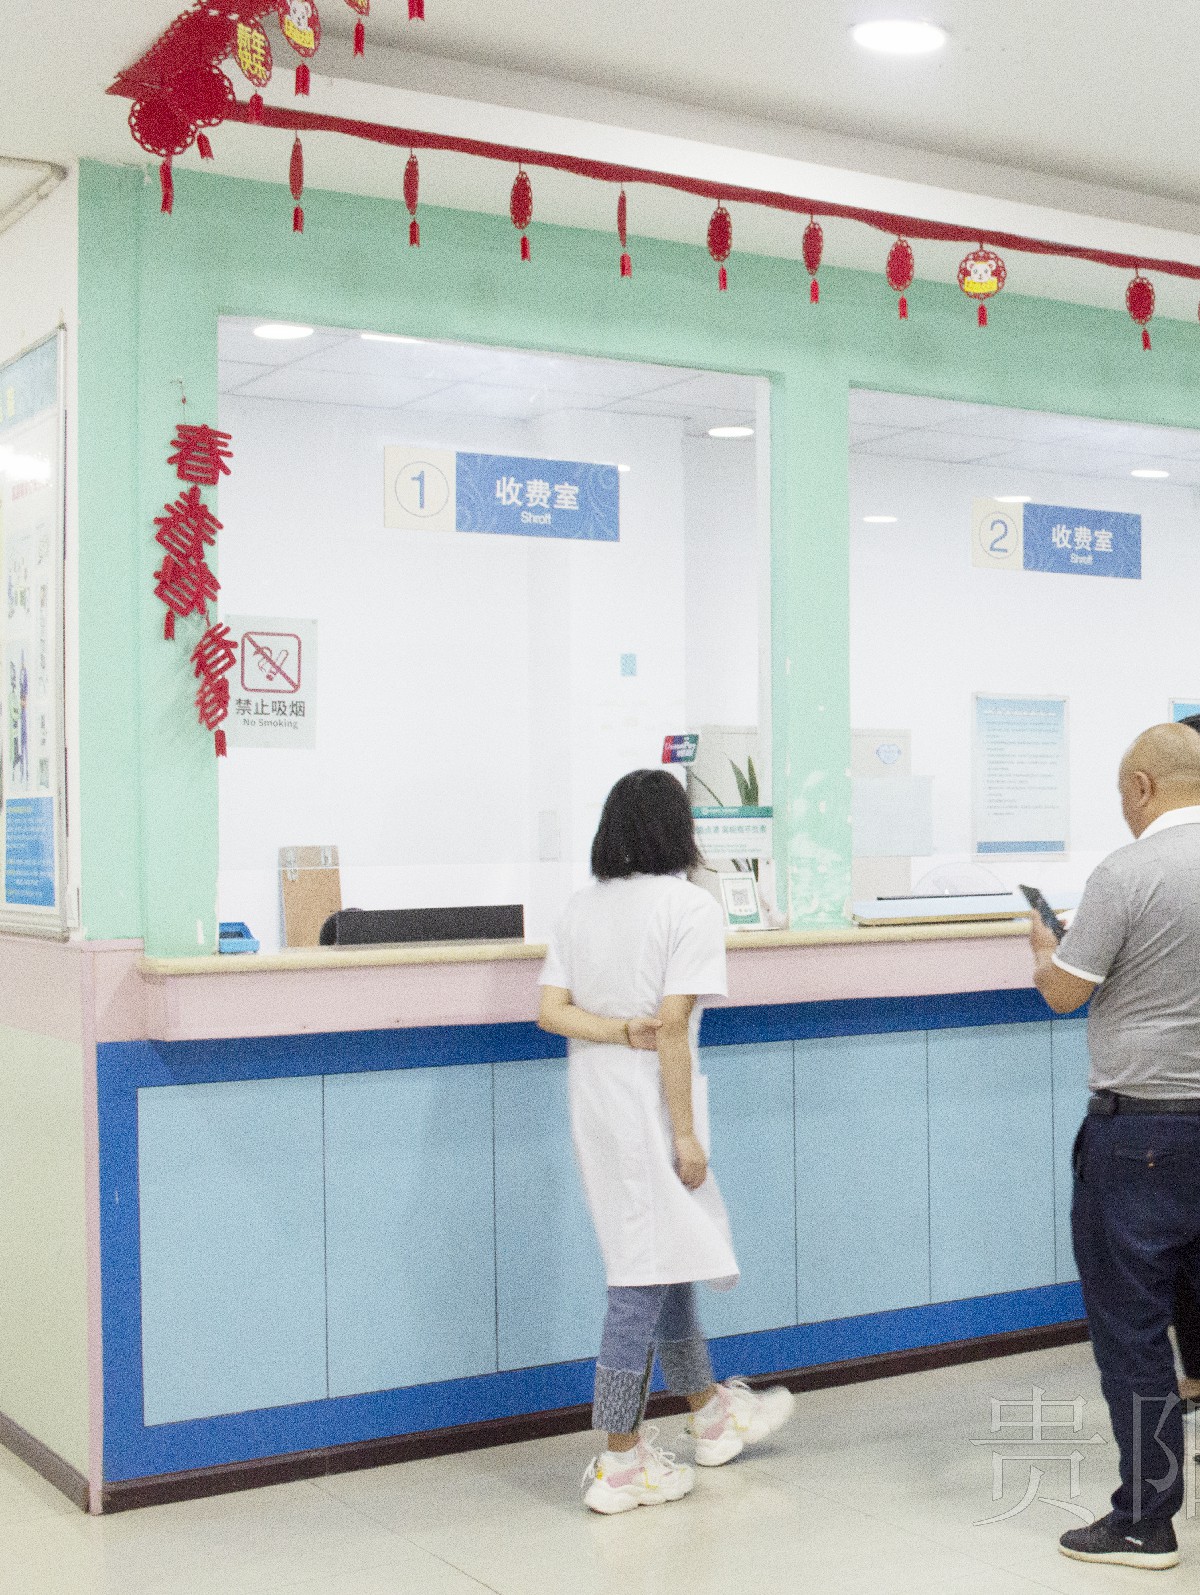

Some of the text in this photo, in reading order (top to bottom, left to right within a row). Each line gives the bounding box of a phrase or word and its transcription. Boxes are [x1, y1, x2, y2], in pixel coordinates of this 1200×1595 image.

[167, 424, 233, 486] 春
[495, 476, 580, 511] 收费室
[989, 519, 1009, 553] 2
[1052, 523, 1114, 553] 收费室
[236, 698, 305, 717] 禁止吸烟
[243, 718, 299, 730] No Smoking
